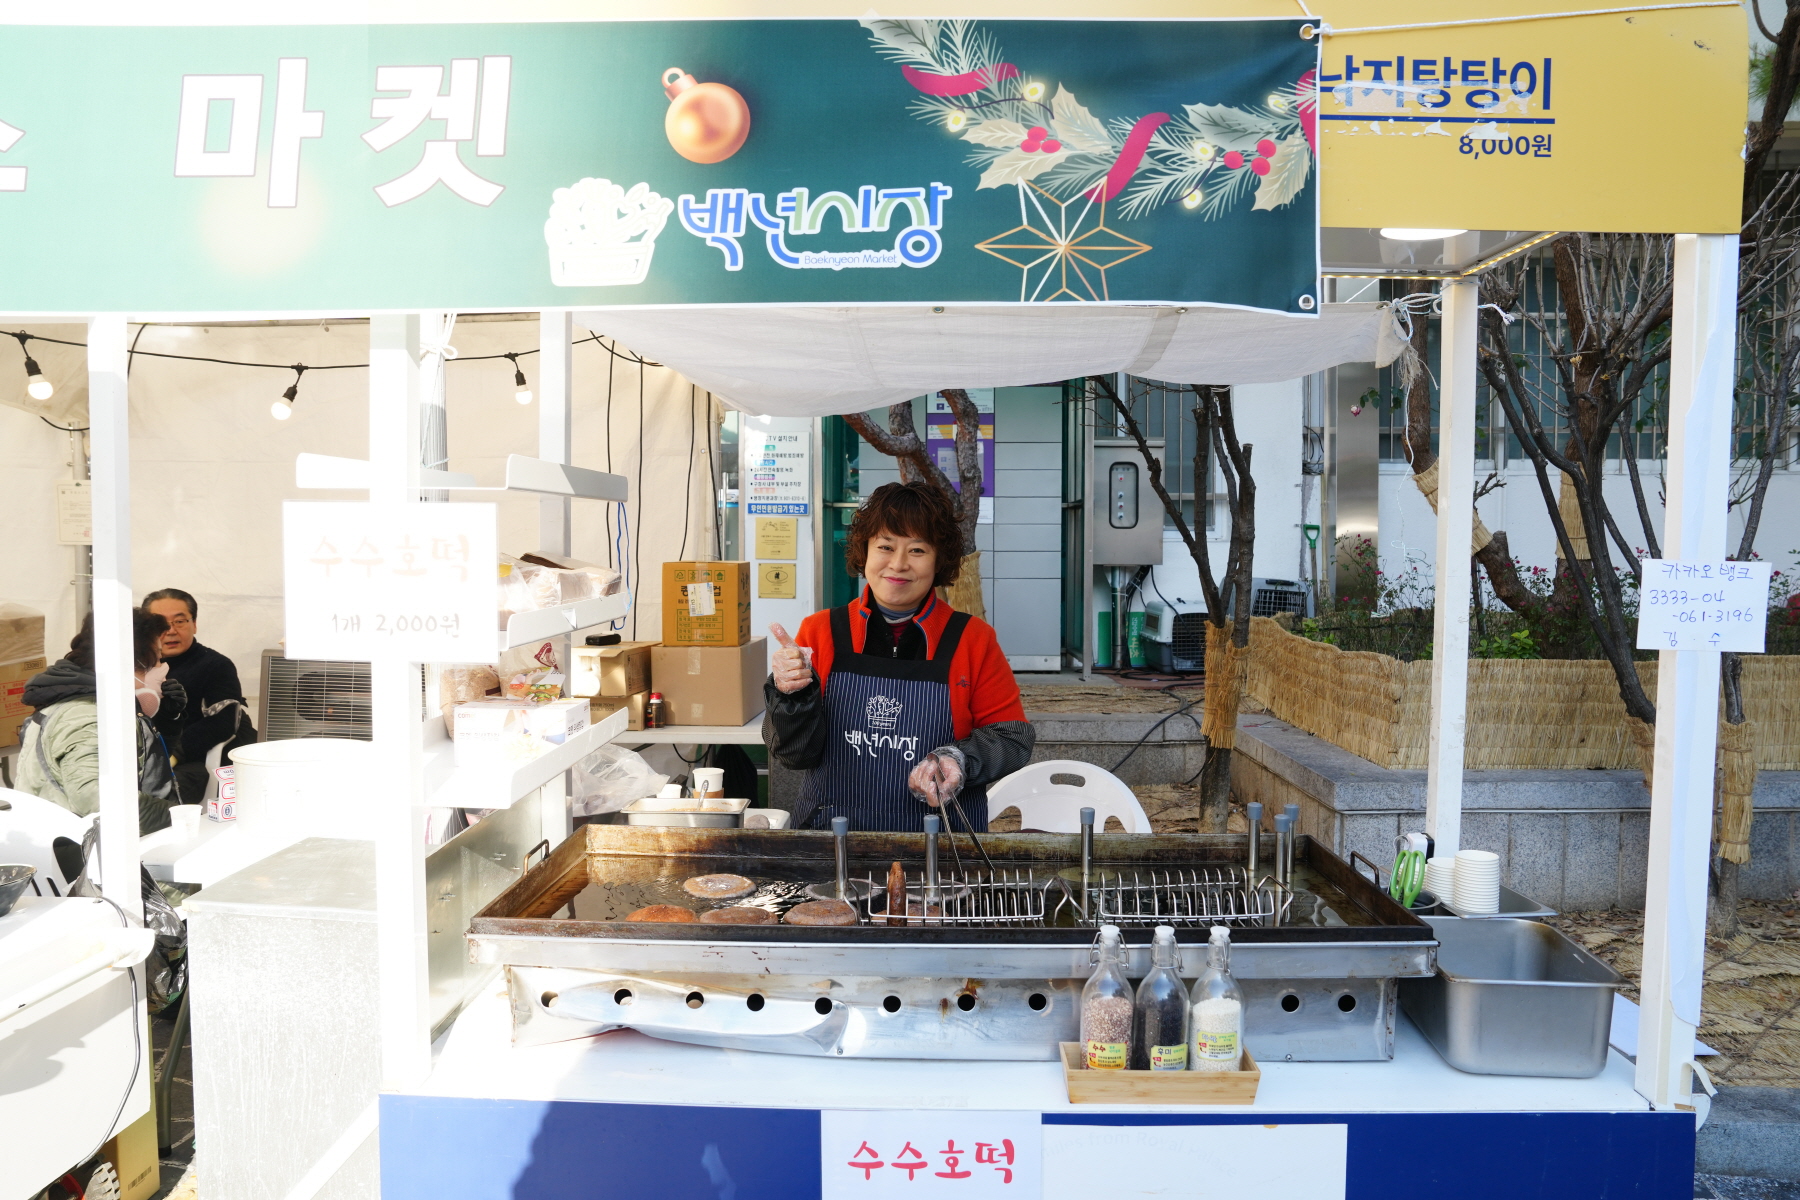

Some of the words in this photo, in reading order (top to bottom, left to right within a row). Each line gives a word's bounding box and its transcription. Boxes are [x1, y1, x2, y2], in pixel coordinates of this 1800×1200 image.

[1319, 54, 1552, 111] 낙지탕탕이
[1458, 133, 1553, 160] 8,000원
[681, 183, 949, 268] 백년시장
[804, 255, 860, 266] Baeknyeon
[862, 254, 898, 264] Market
[310, 534, 470, 583] 수수호떡
[1649, 589, 1726, 605] 3333-04
[331, 613, 361, 633] 1개
[375, 613, 460, 638] 2,000원
[844, 729, 919, 761] 백년시장
[1092, 1043, 1106, 1053] 수수
[846, 1137, 1016, 1185] 수수호떡
